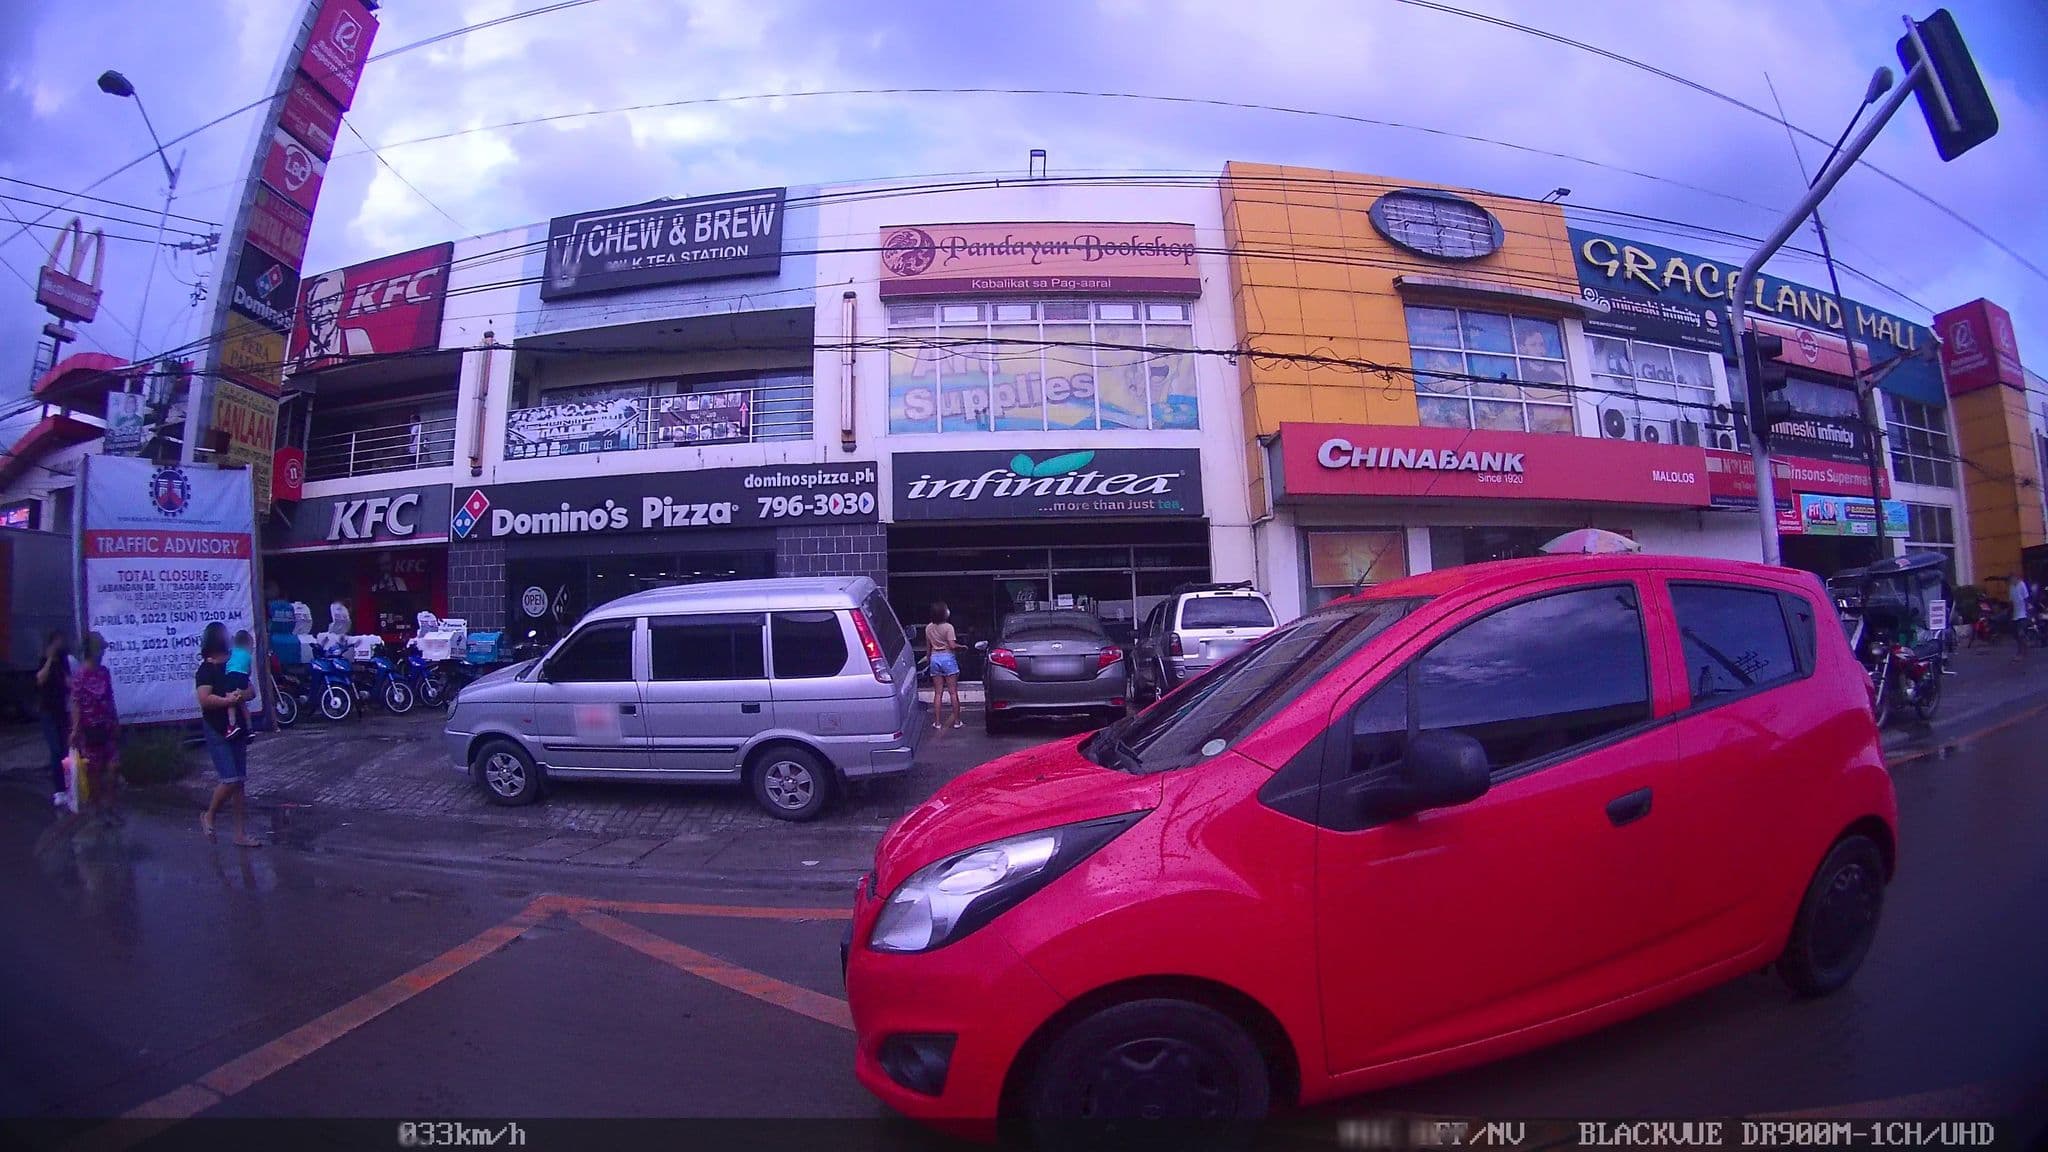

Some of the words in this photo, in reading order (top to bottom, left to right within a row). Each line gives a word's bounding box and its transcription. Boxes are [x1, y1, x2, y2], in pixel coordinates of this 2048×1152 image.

[587, 216, 663, 257] CHEW
[669, 213, 687, 246] &
[694, 203, 776, 243] BREW
[646, 253, 676, 268] TEA
[680, 245, 749, 262] STATION
[940, 235, 1069, 266] Pandayan
[1074, 235, 1196, 266] Bookshop
[346, 267, 439, 319] KFC
[971, 278, 1030, 289] Kabalikat
[1032, 280, 1049, 289] sa
[1051, 278, 1111, 291] Pag-aaral
[1856, 306, 1916, 350] MALL
[904, 372, 1095, 422] Supplies
[1770, 421, 1816, 439] mineski
[1818, 422, 1854, 448] infinity
[1318, 438, 1525, 472] CHINABANK
[744, 469, 875, 490] dominospizza.ph
[908, 469, 1180, 500] infinitea
[1477, 473, 1502, 483] Since
[1504, 474, 1524, 484] 1920
[1652, 470, 1695, 484] MALOLOS
[757, 492, 875, 518] 796-3030
[1093, 499, 1125, 510] than
[326, 494, 419, 541] KFC
[491, 499, 630, 537] Domino's
[642, 497, 733, 529] Pizza
[97, 537, 159, 553] TRAFFIC
[164, 537, 240, 554] ADVISORY
[394, 558, 426, 573] KFC
[117, 570, 156, 581] TOTAL
[158, 570, 209, 581] CLOSURE
[211, 573, 223, 582] OF
[98, 583, 143, 592] LABANGAN
[134, 602, 181, 611] FOLLOWING
[524, 595, 547, 607] OPEN
[95, 615, 123, 626] APRIL
[142, 613, 168, 624] 2022
[170, 611, 198, 623] (SUN)
[200, 611, 226, 621] 12:00
[228, 611, 242, 620] AM
[166, 625, 177, 635] to
[107, 641, 125, 652] RIL
[142, 638, 169, 649] 2022
[144, 663, 200, 674] CONSTRUCTIO
